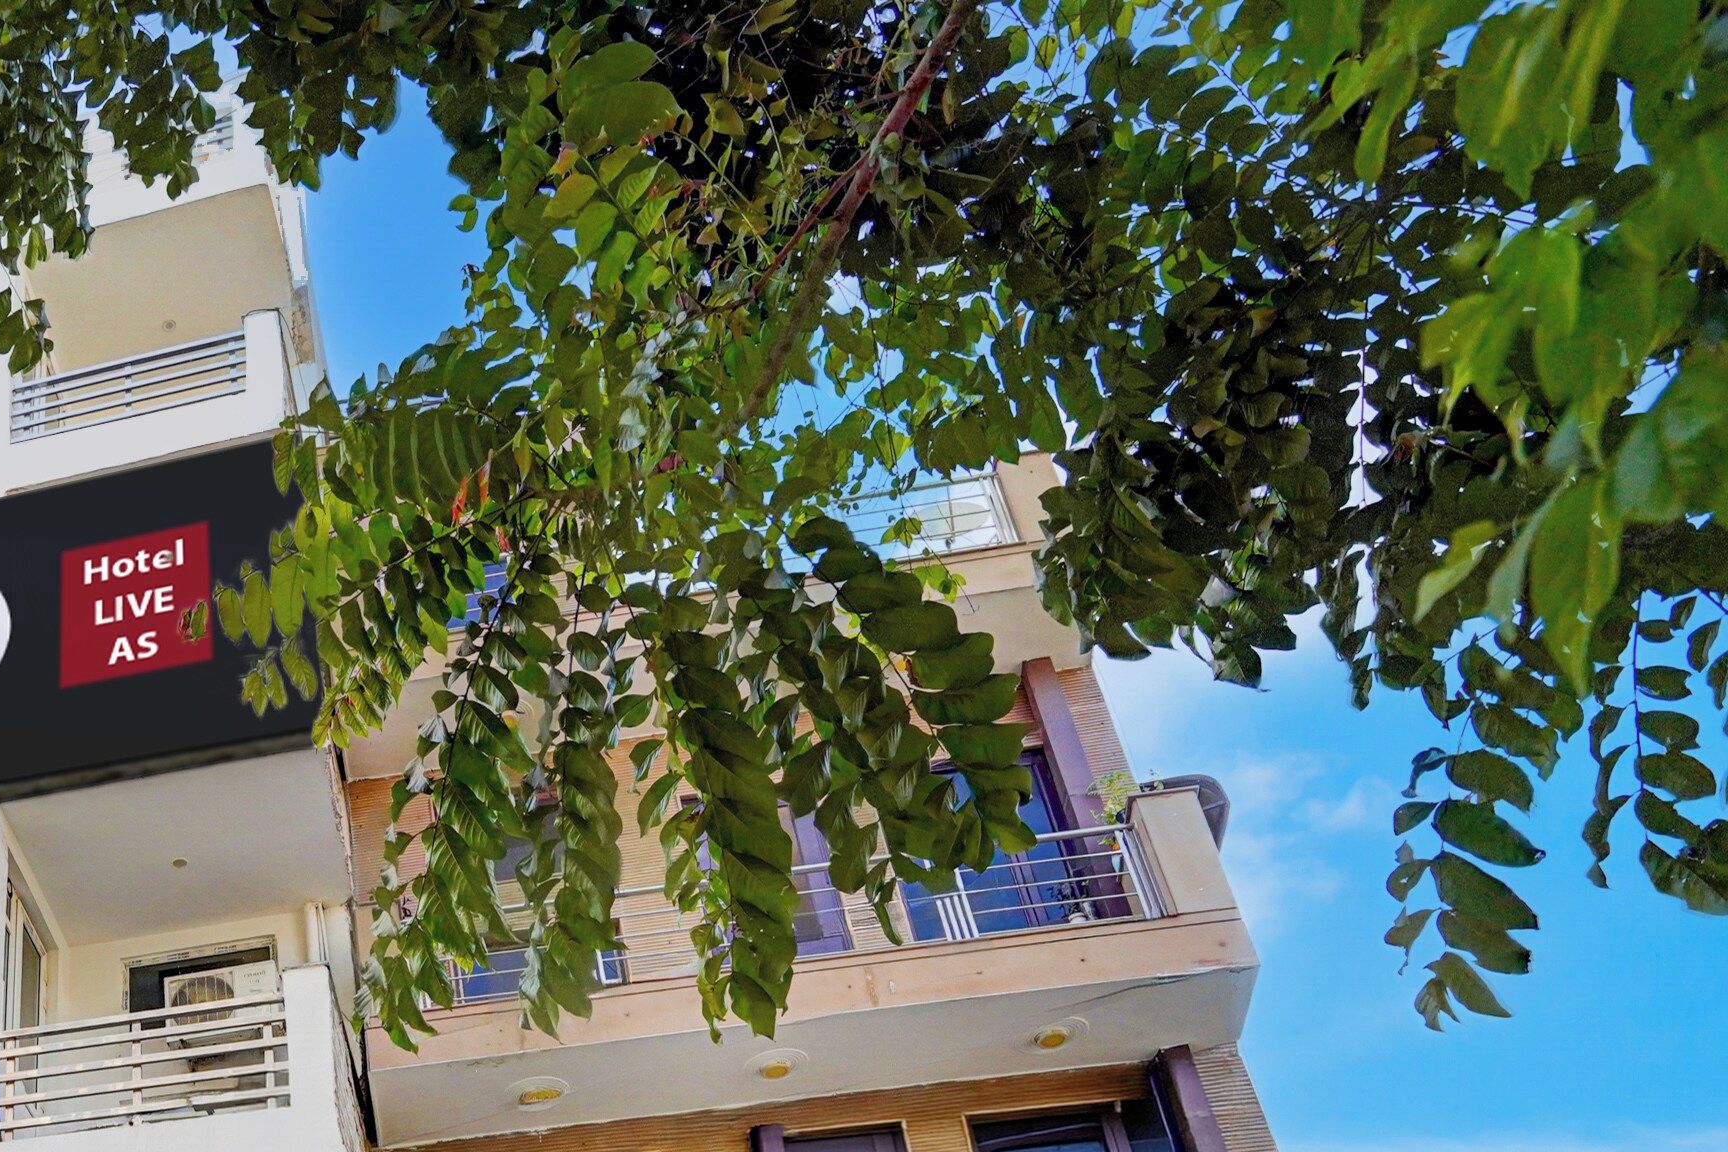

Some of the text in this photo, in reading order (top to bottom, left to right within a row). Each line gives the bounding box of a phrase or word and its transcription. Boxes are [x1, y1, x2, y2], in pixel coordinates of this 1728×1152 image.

[84, 538, 184, 585] Hotel
[94, 585, 174, 626] LIVE
[108, 631, 159, 665] AS
